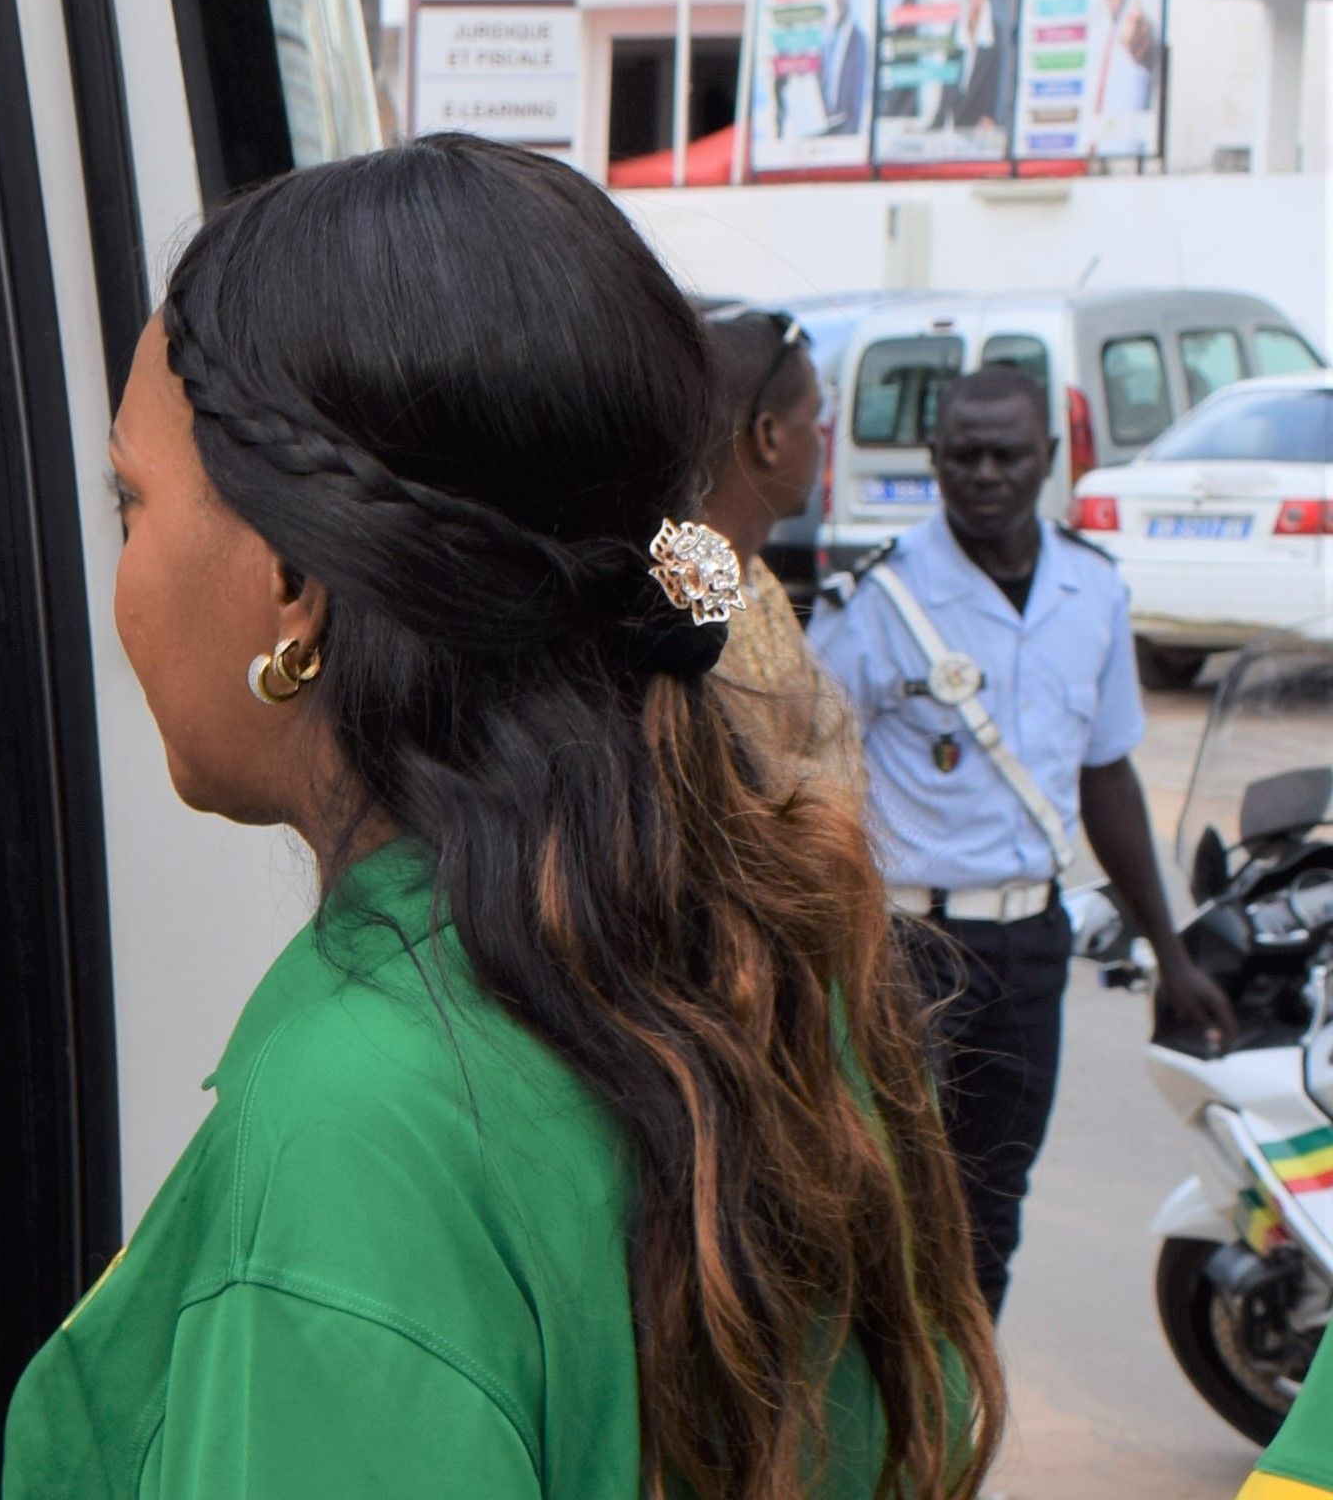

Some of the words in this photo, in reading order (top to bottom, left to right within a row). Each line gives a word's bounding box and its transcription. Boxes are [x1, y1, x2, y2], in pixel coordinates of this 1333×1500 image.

[453, 21, 551, 40] JURIDIQUE
[446, 47, 470, 66] ET
[477, 46, 553, 66] FISCALE
